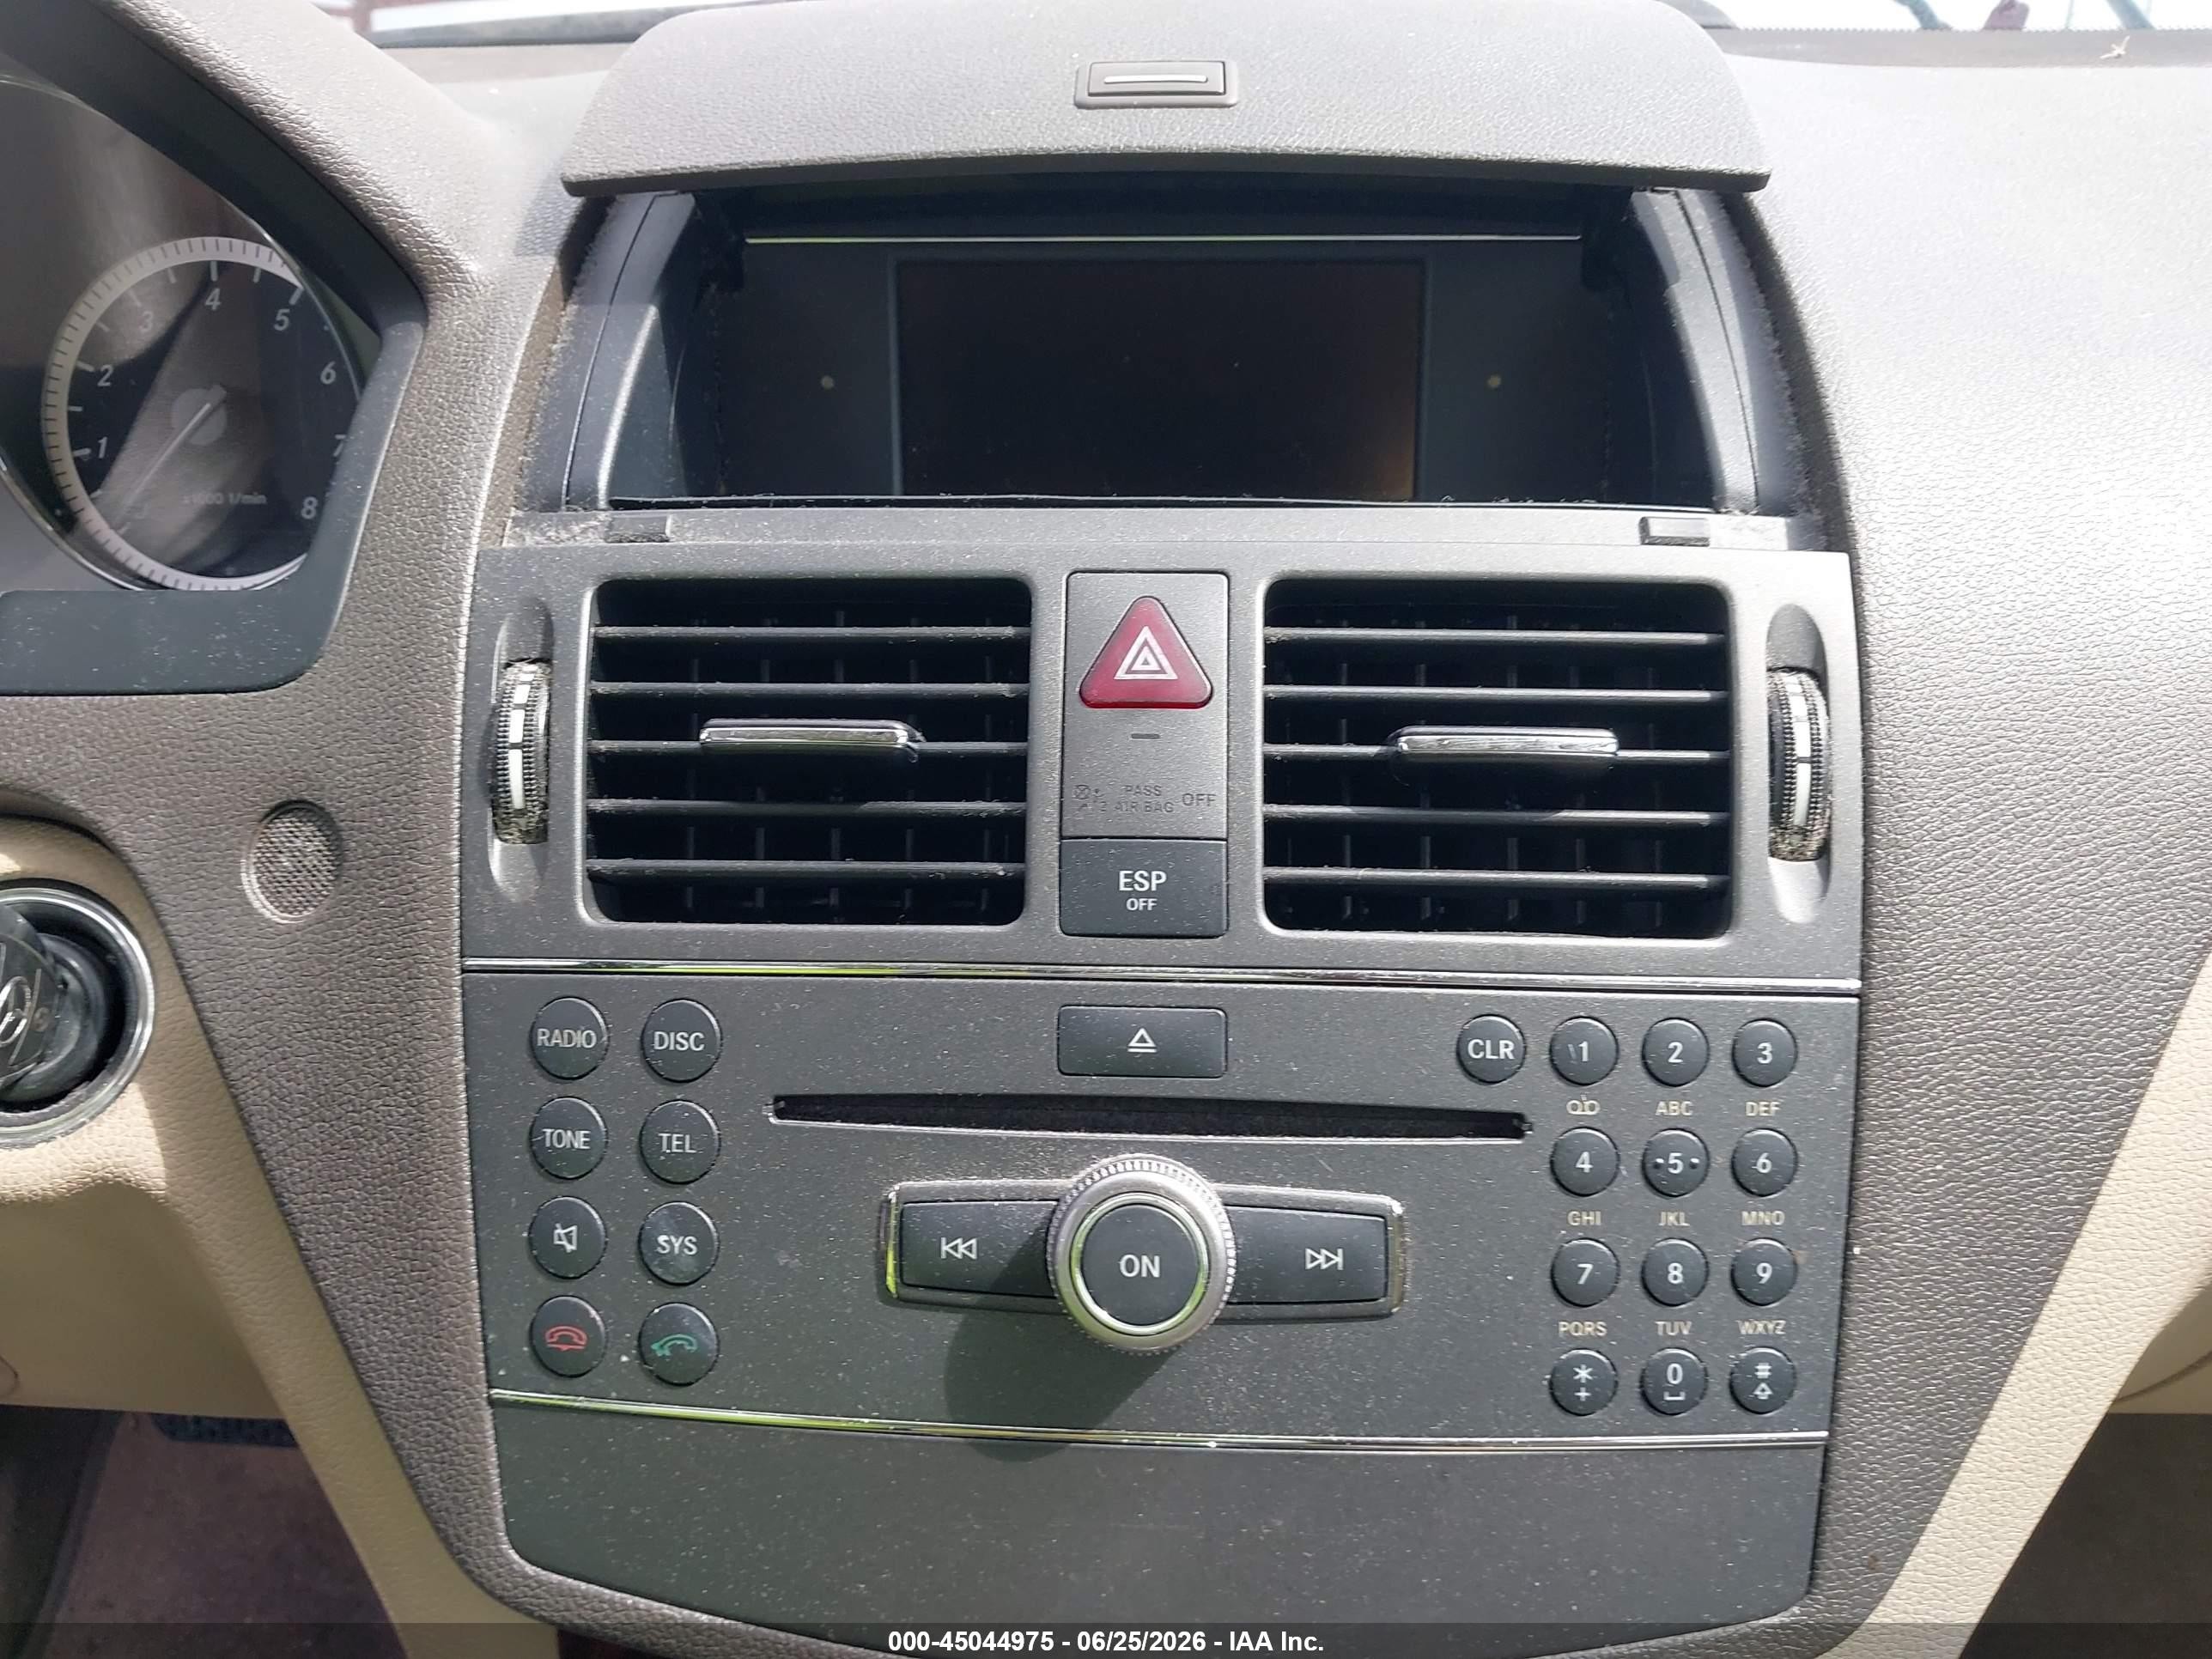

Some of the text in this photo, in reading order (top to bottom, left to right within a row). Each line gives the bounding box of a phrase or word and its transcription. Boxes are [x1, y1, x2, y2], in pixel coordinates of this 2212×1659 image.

[205, 289, 222, 310] 4
[139, 311, 154, 332] 3
[274, 308, 289, 331] 5
[98, 366, 112, 386] 2
[320, 362, 336, 385] 6
[97, 436, 107, 459] 1
[333, 434, 346, 457] 7
[301, 496, 318, 520] 8
[1124, 785, 1162, 797] PASS
[1182, 792, 1217, 807] OFF
[1119, 870, 1167, 891] ESP
[1127, 898, 1158, 911] OFF
[537, 1029, 597, 1049] RADIO
[653, 1032, 705, 1052] DISC
[1468, 1039, 1515, 1060] CLR
[1579, 1042, 1589, 1062] 1
[1668, 1042, 1683, 1063] 2
[1757, 1042, 1772, 1064] 3
[1656, 1101, 1693, 1116] ABC
[1746, 1102, 1780, 1116] DEF
[543, 1128, 591, 1149] TONE
[659, 1133, 696, 1153] TEL
[1575, 1152, 1593, 1173] 4
[1668, 1152, 1684, 1174] 5
[1757, 1152, 1772, 1174] 6
[1567, 1211, 1601, 1226] GHI
[1658, 1211, 1690, 1226] JKL
[1741, 1211, 1785, 1226] MNO
[657, 1234, 698, 1256] SYS
[1120, 1255, 1161, 1278] ON
[1577, 1263, 1594, 1285] 7
[1668, 1262, 1684, 1285] 8
[1756, 1262, 1773, 1284] 9
[1559, 1321, 1607, 1336] PQRS
[1656, 1321, 1692, 1335] TUV
[1738, 1320, 1787, 1335] WXYZ
[1667, 1363, 1684, 1384] 0
